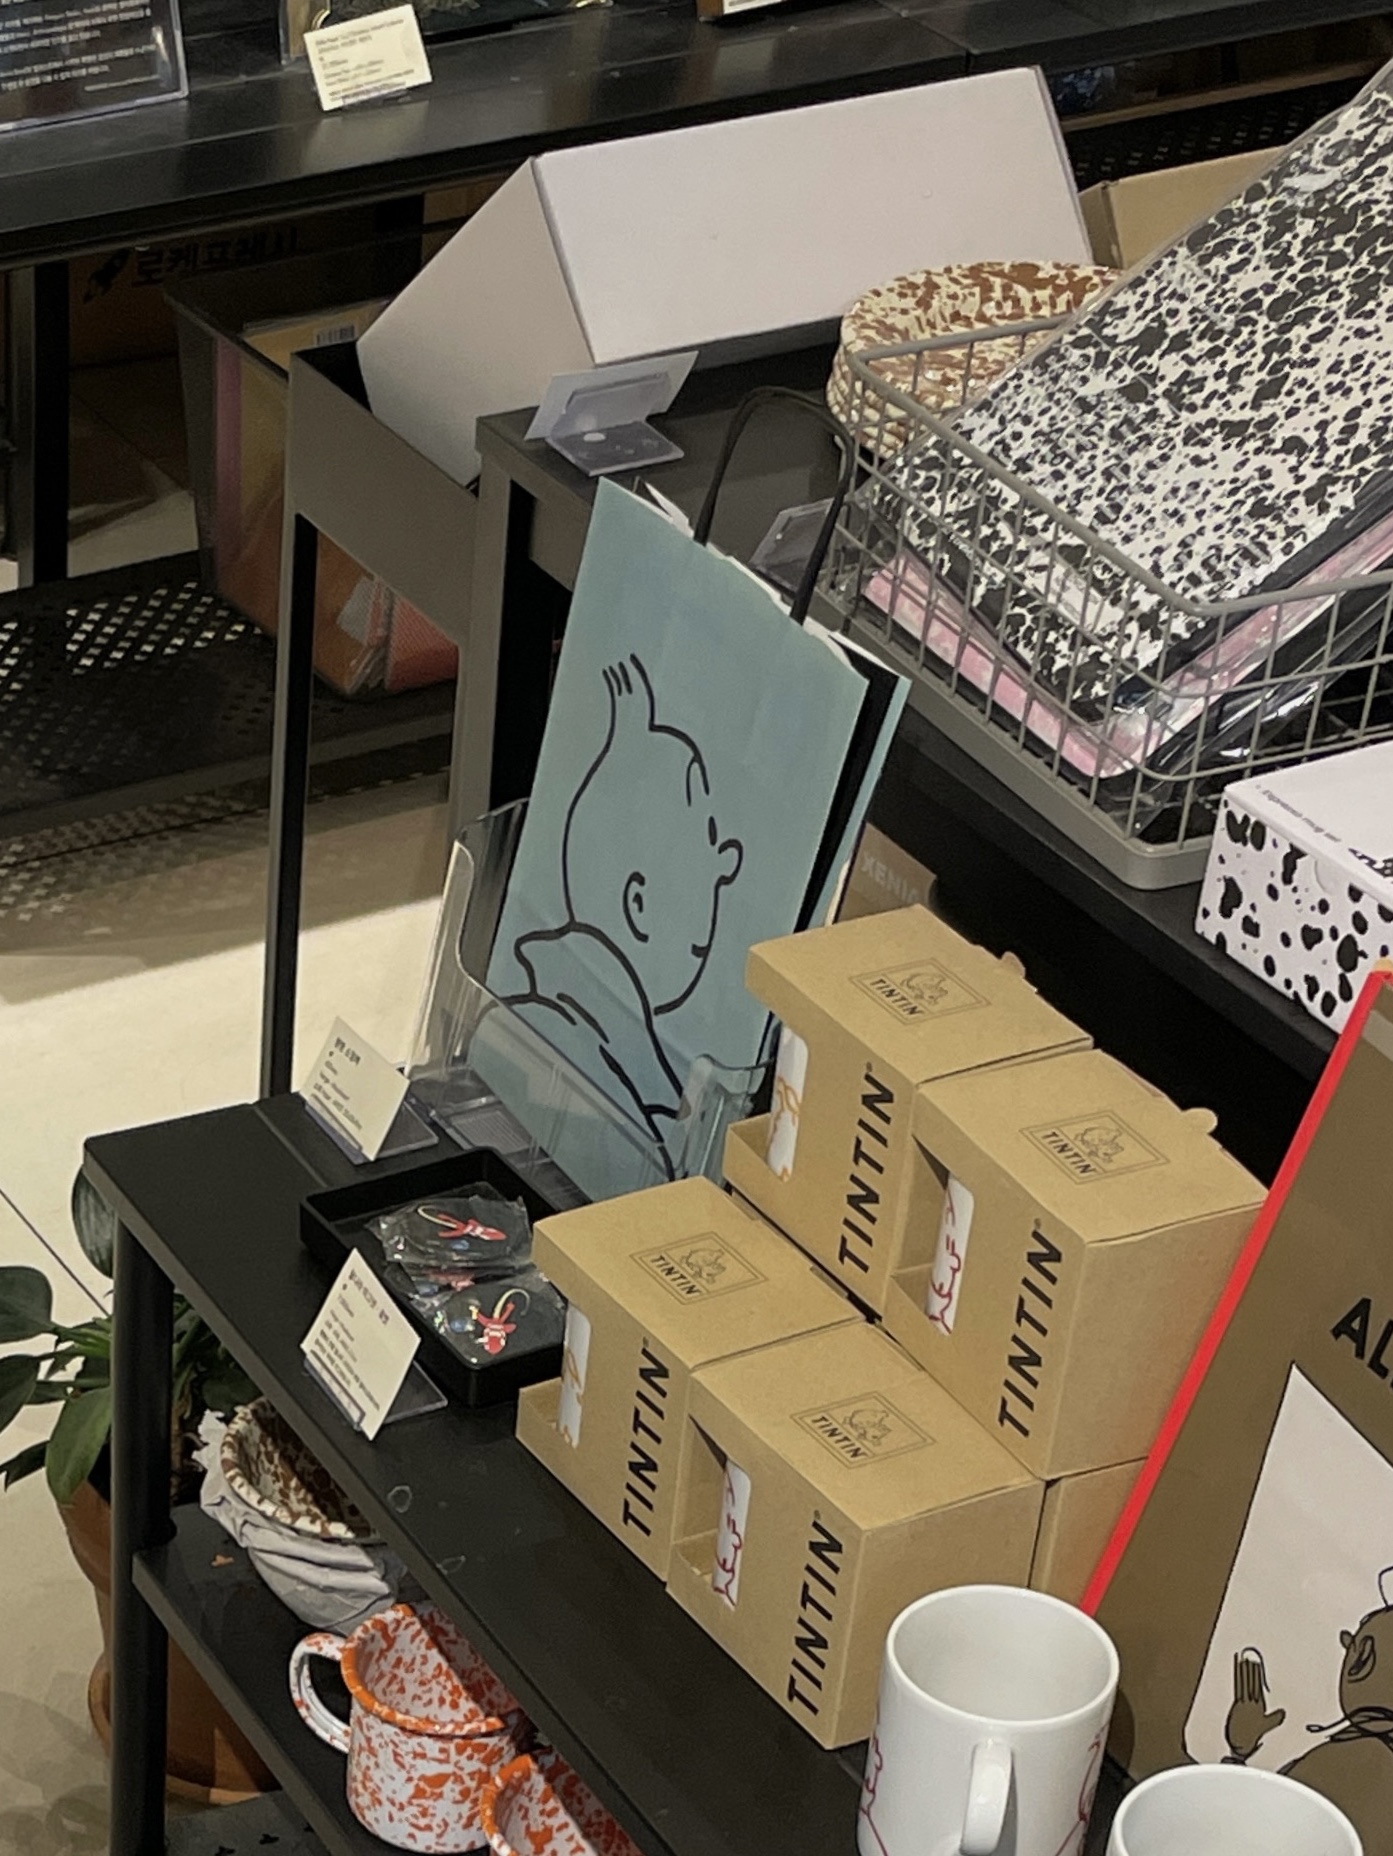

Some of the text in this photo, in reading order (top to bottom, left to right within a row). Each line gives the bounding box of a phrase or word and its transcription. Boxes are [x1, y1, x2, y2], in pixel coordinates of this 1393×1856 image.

[870, 977, 924, 1016] TINTIN
[838, 1073, 894, 1274] TINTIN
[1041, 1130, 1097, 1175] TINTIN
[650, 1254, 702, 1296] TINTIN
[998, 1230, 1063, 1438] TINTIN
[1330, 1297, 1393, 1389] AL
[622, 1347, 670, 1538] TINTIN
[811, 1415, 869, 1460] TINTIN
[787, 1519, 844, 1717] TINTIN
